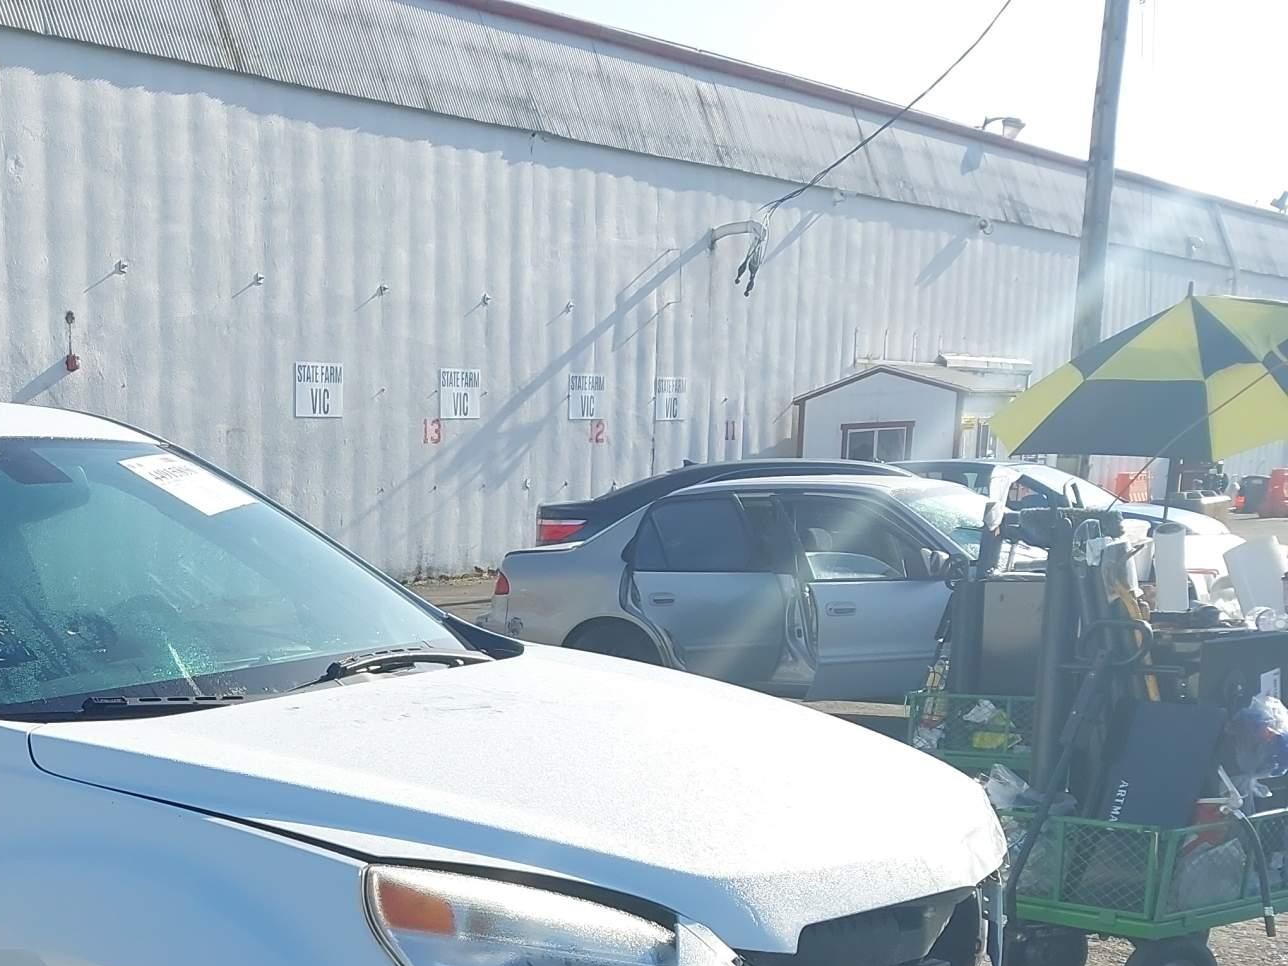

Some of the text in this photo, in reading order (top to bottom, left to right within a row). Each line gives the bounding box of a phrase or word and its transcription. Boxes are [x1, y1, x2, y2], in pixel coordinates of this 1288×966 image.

[297, 364, 343, 384] STATE FARM
[441, 370, 480, 388] STATE FARM
[571, 375, 605, 391] STATE FARM
[310, 388, 330, 415] VIC
[453, 392, 469, 417] VIC
[581, 395, 595, 417] VIC
[665, 397, 678, 418] VIC
[423, 418, 441, 444] 13
[589, 420, 605, 443] 12
[724, 420, 736, 441] 11
